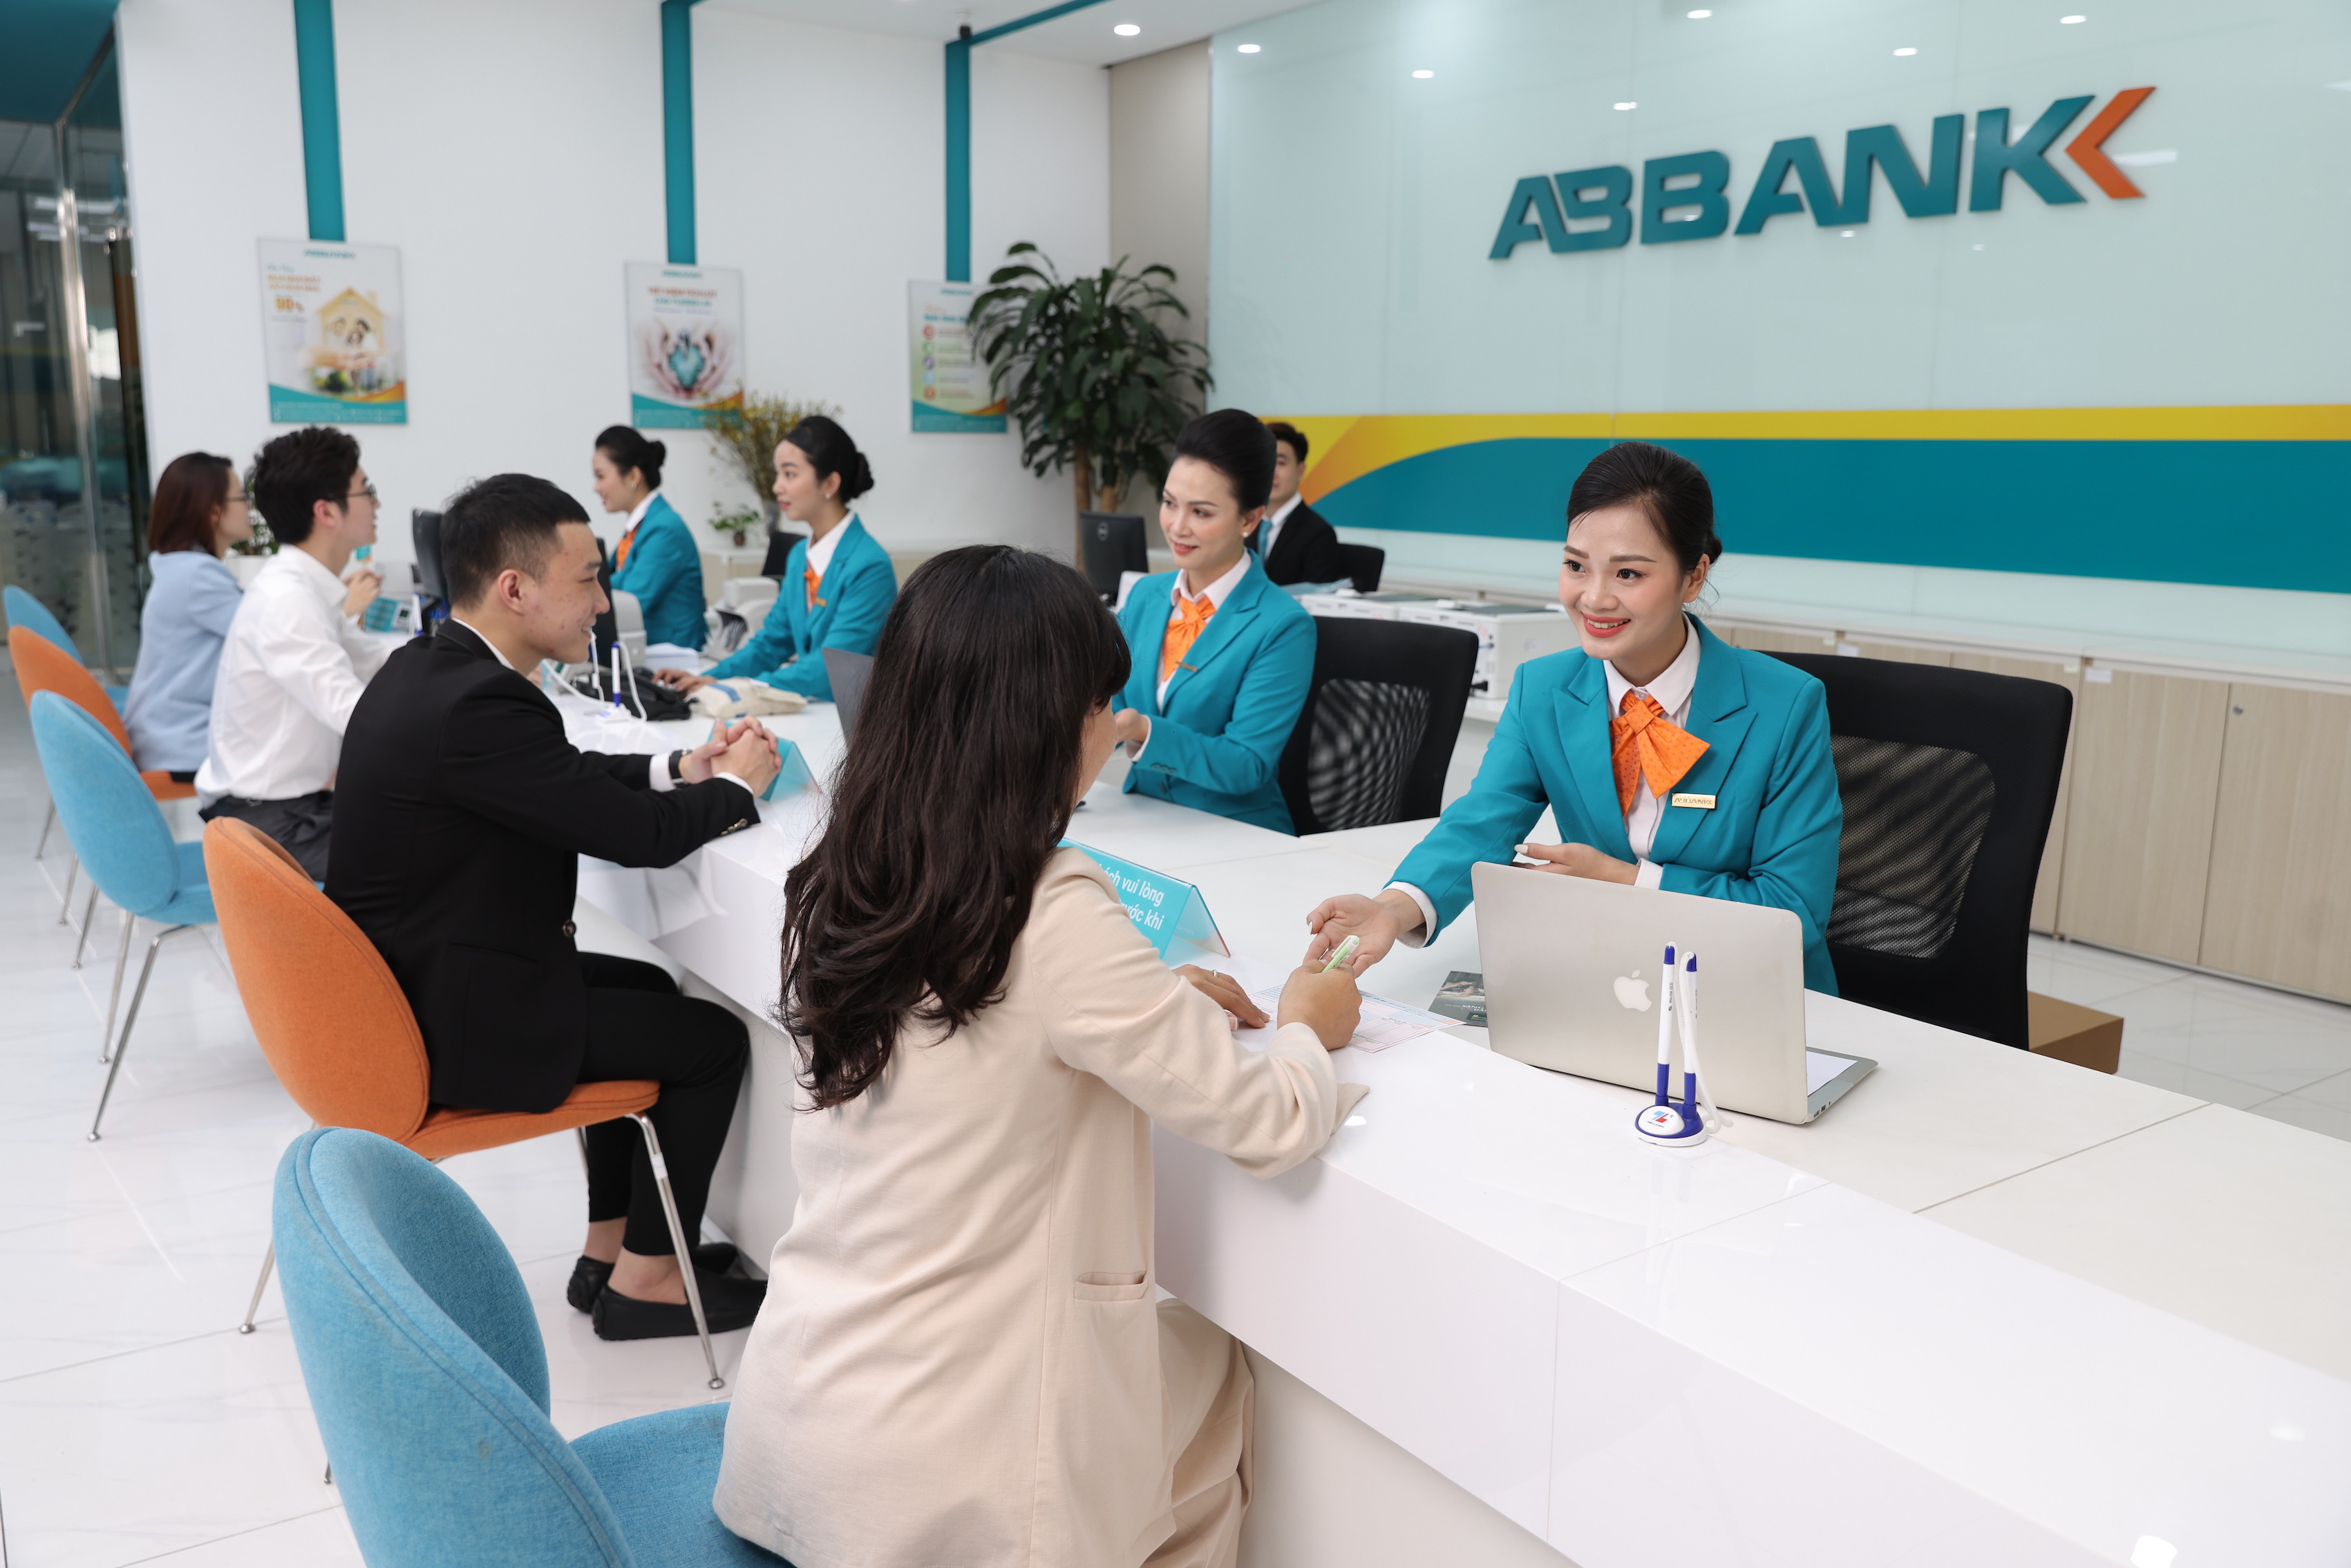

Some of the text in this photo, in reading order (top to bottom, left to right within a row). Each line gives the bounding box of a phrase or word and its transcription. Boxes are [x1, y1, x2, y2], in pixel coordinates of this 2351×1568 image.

[1122, 878, 1141, 894] vui
[1138, 880, 1164, 907] lòng
[1144, 909, 1165, 930] khi
